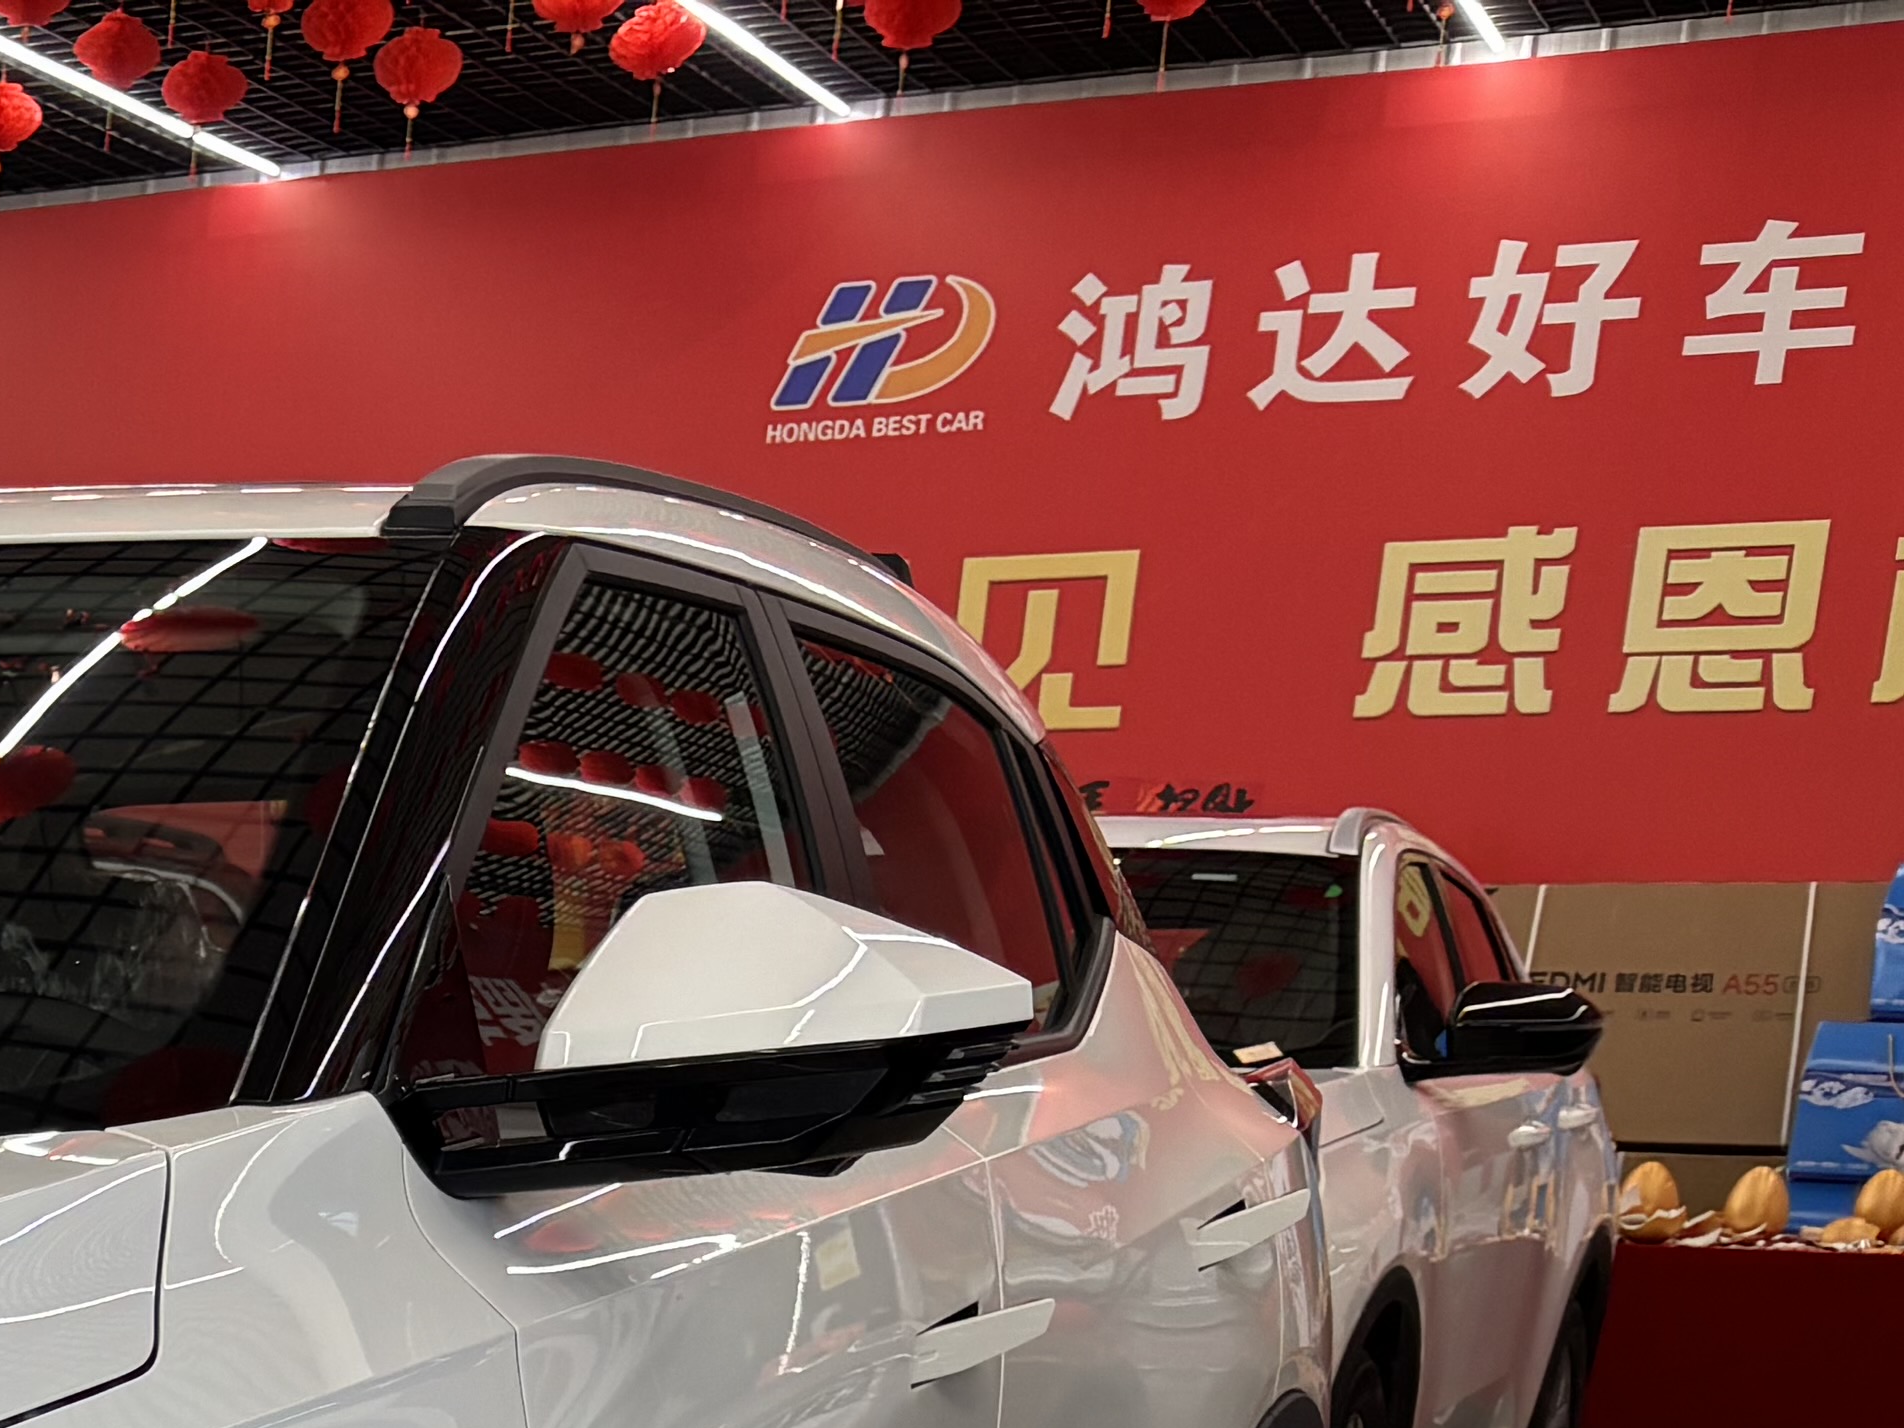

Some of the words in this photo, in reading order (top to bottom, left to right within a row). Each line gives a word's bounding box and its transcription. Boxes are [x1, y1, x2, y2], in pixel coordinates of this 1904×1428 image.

[1047, 219, 1866, 420] 鸿达好车
[766, 418, 867, 445] HONGDA
[873, 413, 932, 436] BEST
[937, 410, 985, 433] CAR
[1352, 518, 1904, 720] 感恩
[1615, 972, 1713, 993] 智能电视
[1723, 974, 1778, 995] A55
